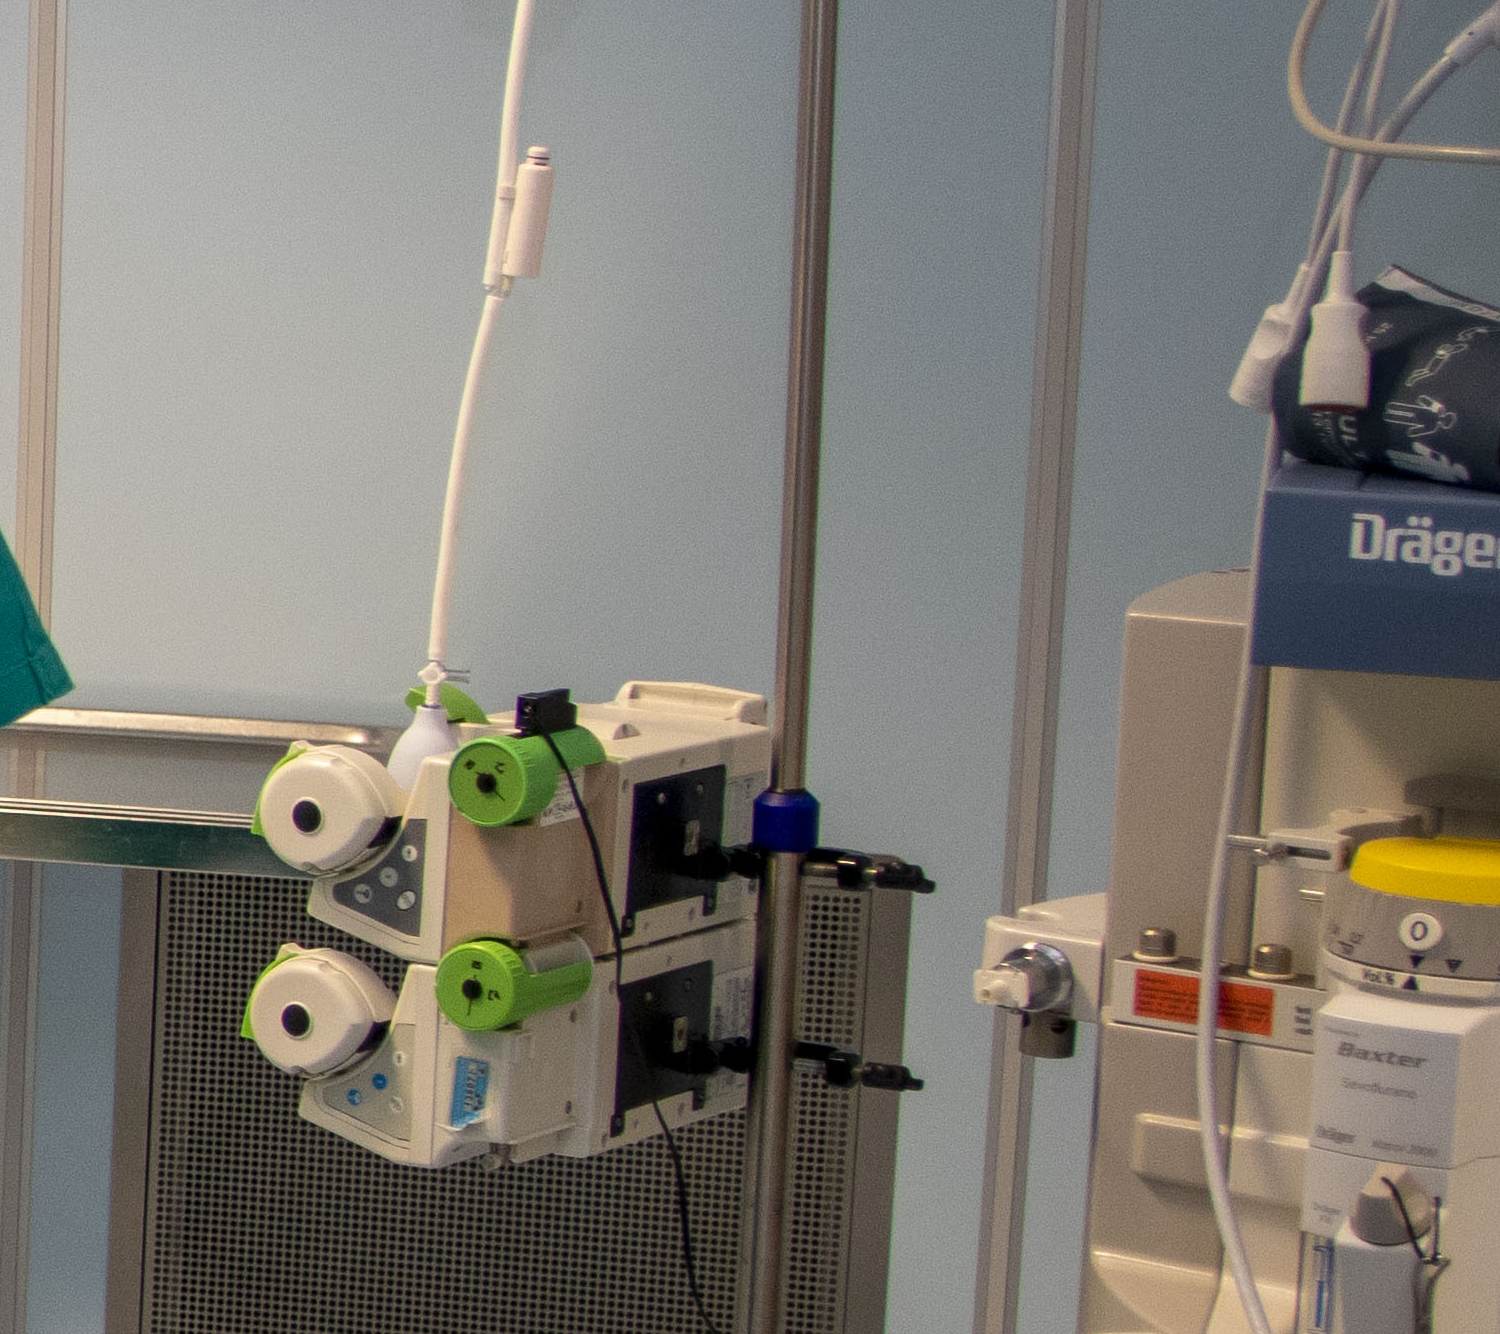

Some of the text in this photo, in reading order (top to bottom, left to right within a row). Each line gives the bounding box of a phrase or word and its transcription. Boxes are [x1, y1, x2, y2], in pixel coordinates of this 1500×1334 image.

[1351, 512, 1500, 576] Dräge
[1410, 920, 1428, 942] 0
[1338, 1041, 1427, 1068] Baxter
